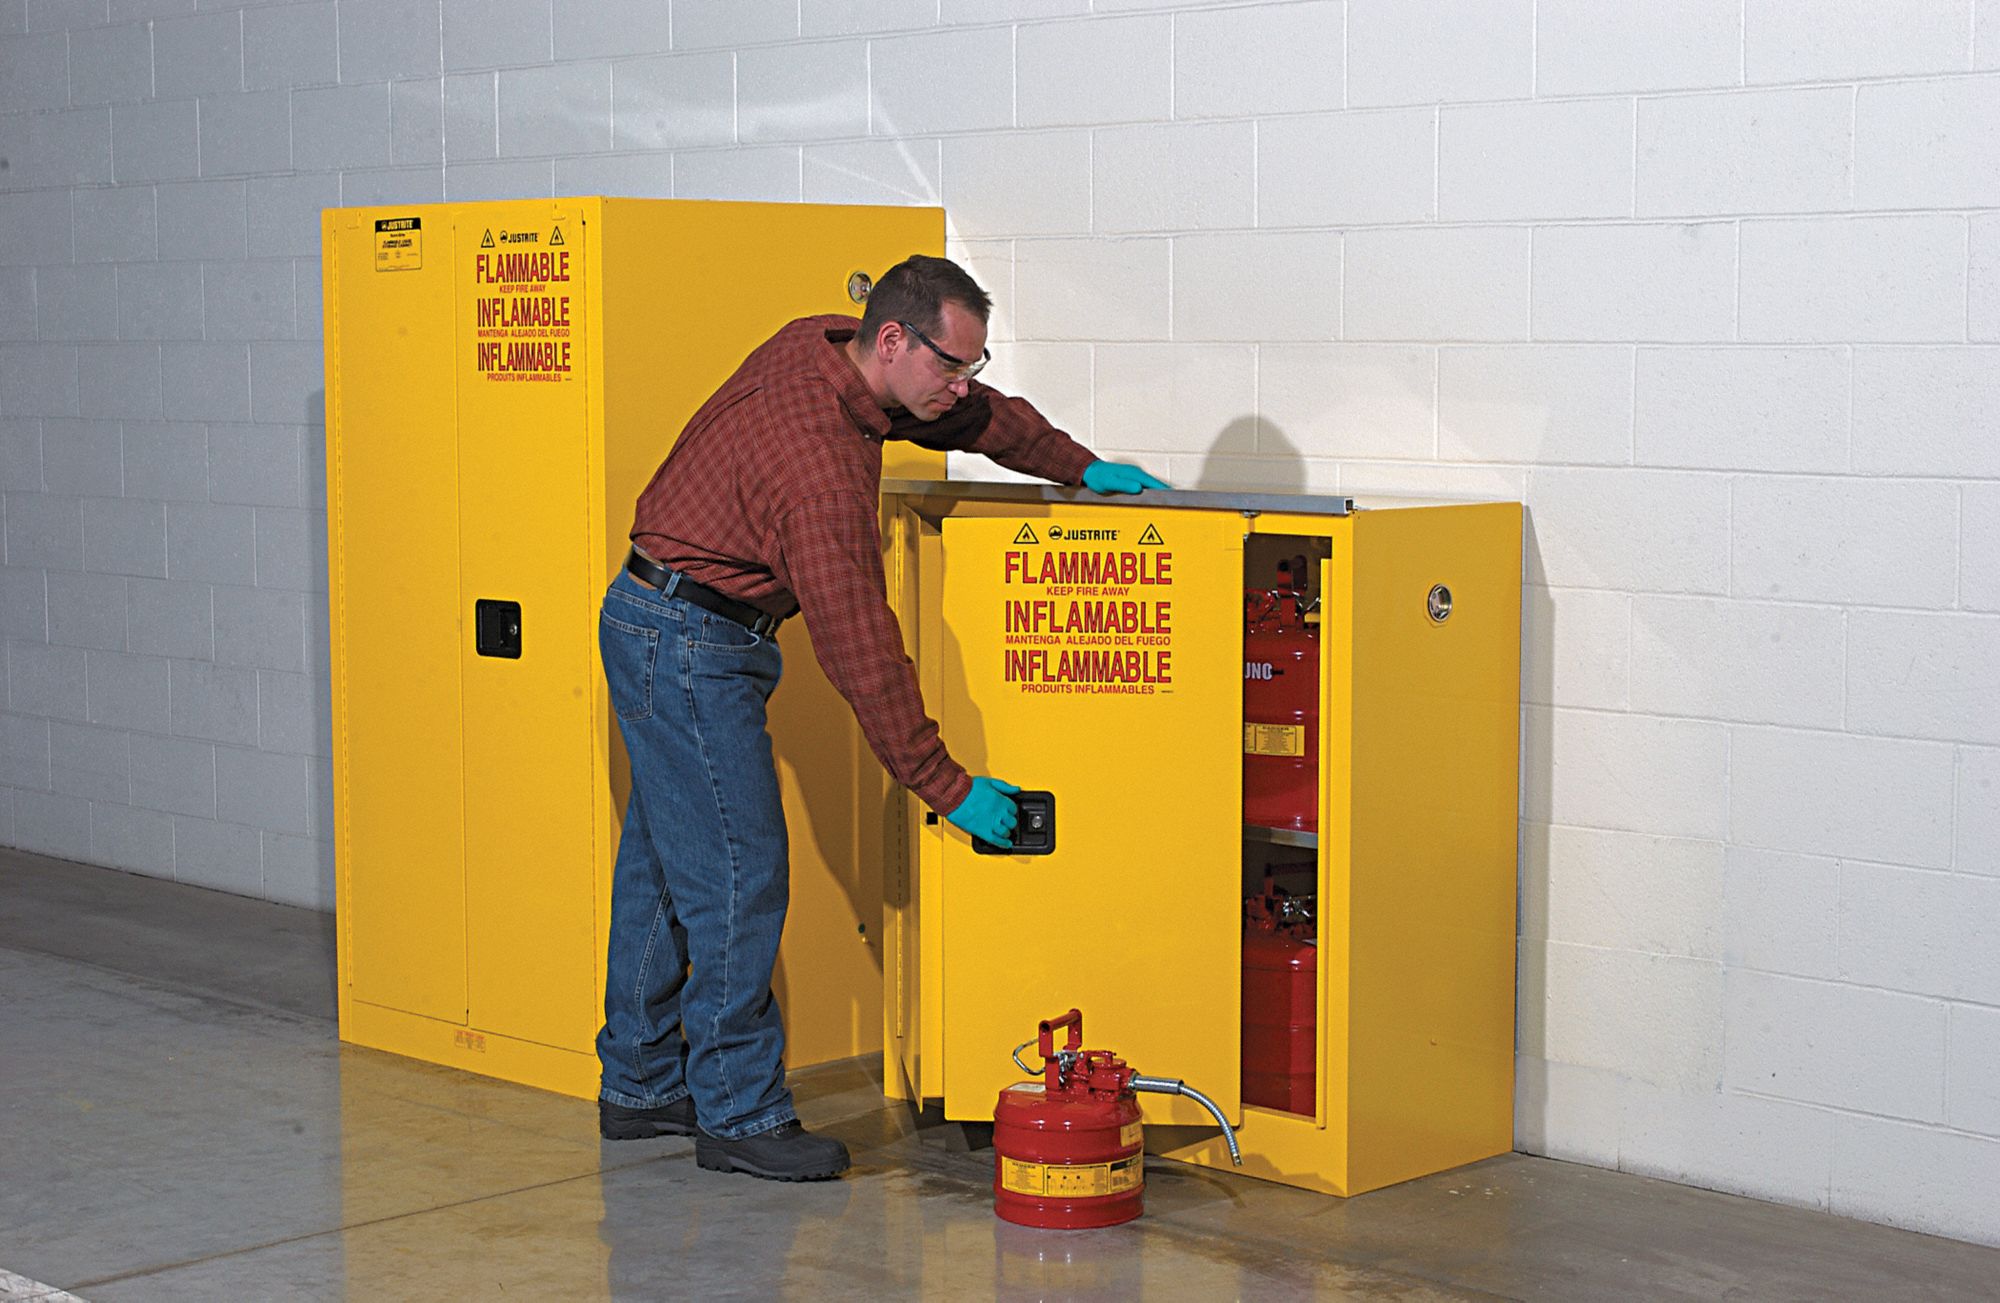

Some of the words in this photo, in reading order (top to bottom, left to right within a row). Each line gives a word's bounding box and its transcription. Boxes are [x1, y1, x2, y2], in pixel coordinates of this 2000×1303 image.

[508, 232, 538, 243] JUSTRITE
[476, 252, 570, 283] FLAMMABLE
[499, 285, 514, 293] KEEP
[516, 285, 528, 293] FIRE
[530, 284, 546, 293] AWAY
[477, 297, 570, 327] INFLAMABLE
[478, 329, 508, 338] MANTENGA
[511, 329, 536, 338] ALEJADO
[538, 329, 549, 337] DEL
[550, 329, 570, 337] FUEGO
[477, 342, 571, 372] INFLAMMABLE
[487, 373, 515, 382] PRODUITS
[516, 373, 561, 382] INFLAMMABLES
[1064, 529, 1118, 541] JUSTRITE
[1005, 551, 1172, 585] FLAMMABLE
[1046, 586, 1073, 596] KEEP
[1076, 586, 1099, 596] FIRE
[1101, 586, 1130, 596] AWAY
[1005, 600, 1171, 634] INFLAMABLE
[1006, 635, 1061, 645] MANTENGA
[1066, 635, 1112, 645] ALEJADO
[1114, 635, 1133, 645] DEL
[1136, 635, 1171, 646] FUEGO
[1004, 650, 1172, 683] INFLAMMABLE
[1021, 684, 1072, 694] PRODUITS
[1074, 684, 1155, 694] INFLAMMABLES
